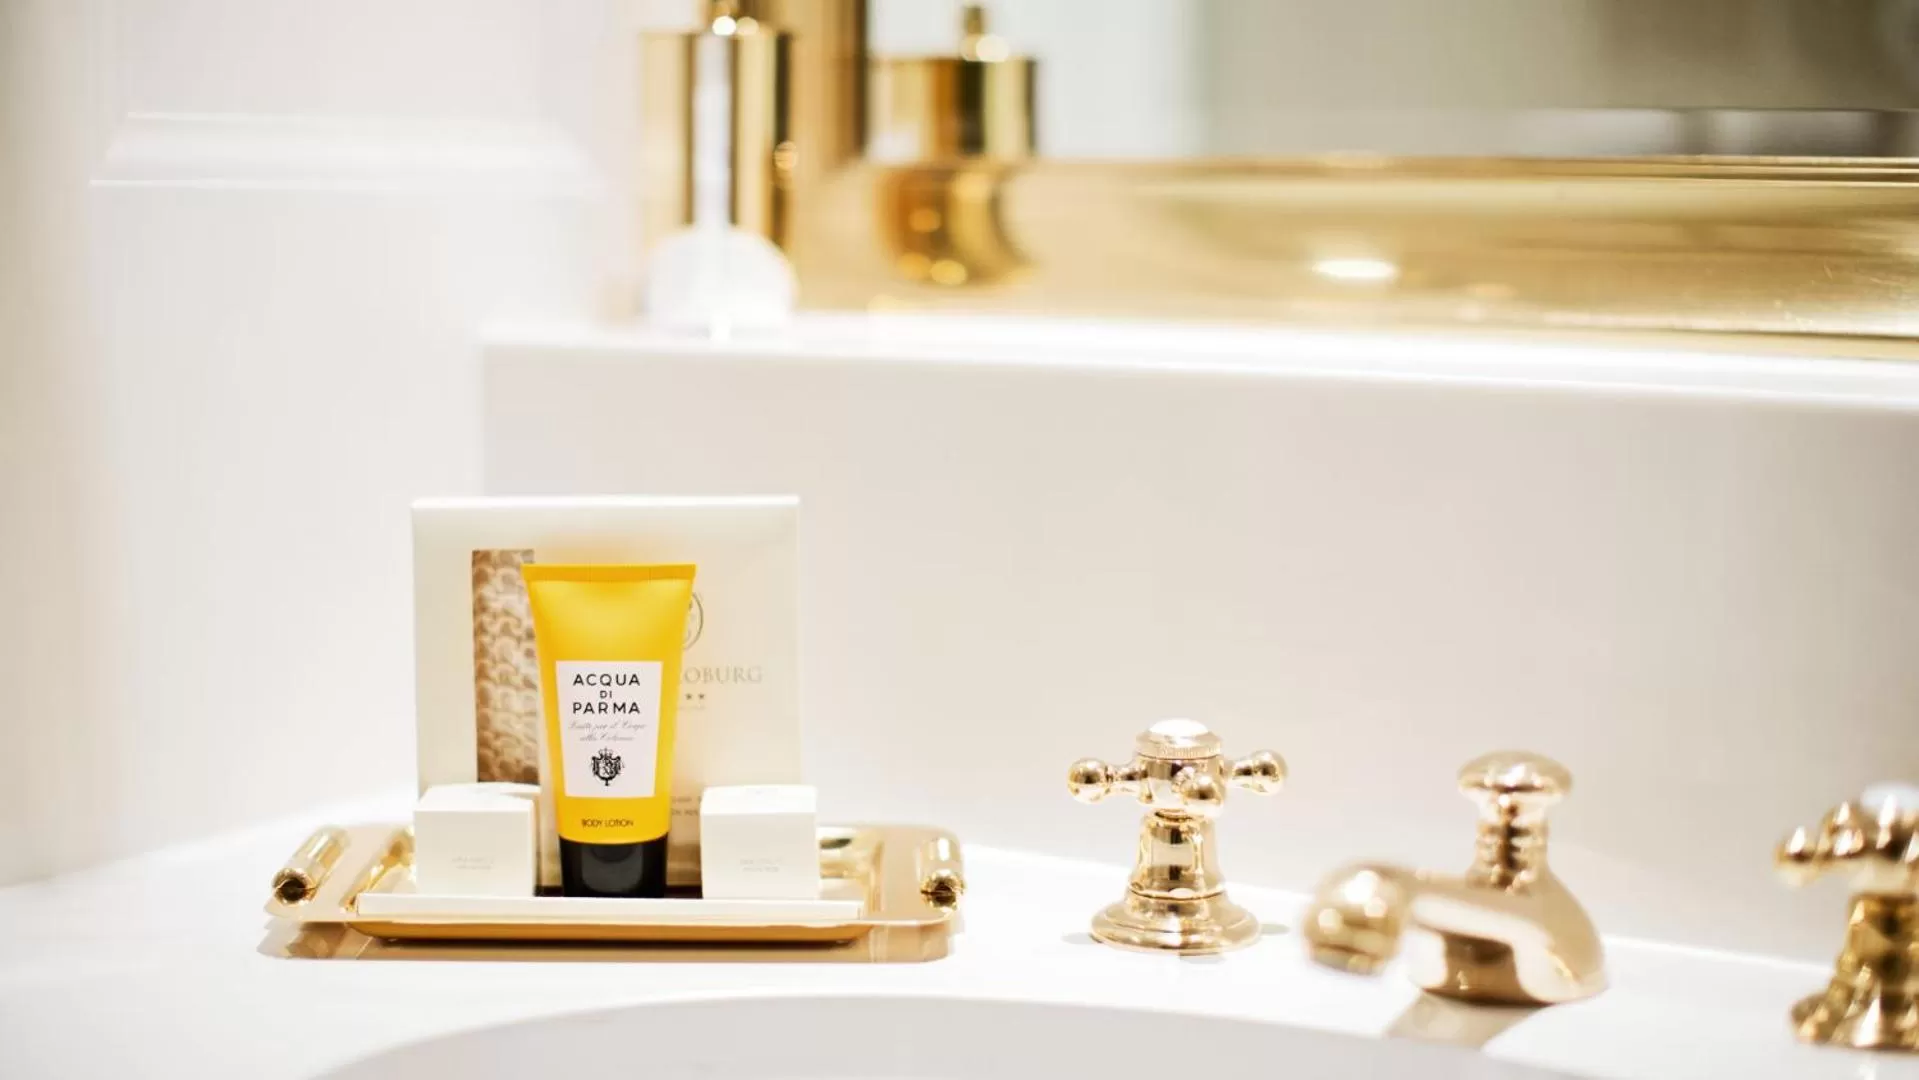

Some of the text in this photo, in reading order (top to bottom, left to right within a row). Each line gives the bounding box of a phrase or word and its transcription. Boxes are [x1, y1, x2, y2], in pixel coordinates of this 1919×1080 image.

[572, 673, 641, 687] ACQUA
[680, 665, 764, 684] OBURG
[599, 690, 613, 699] DI
[572, 702, 641, 714] PARMA
[581, 818, 634, 828] BODY LOTION
